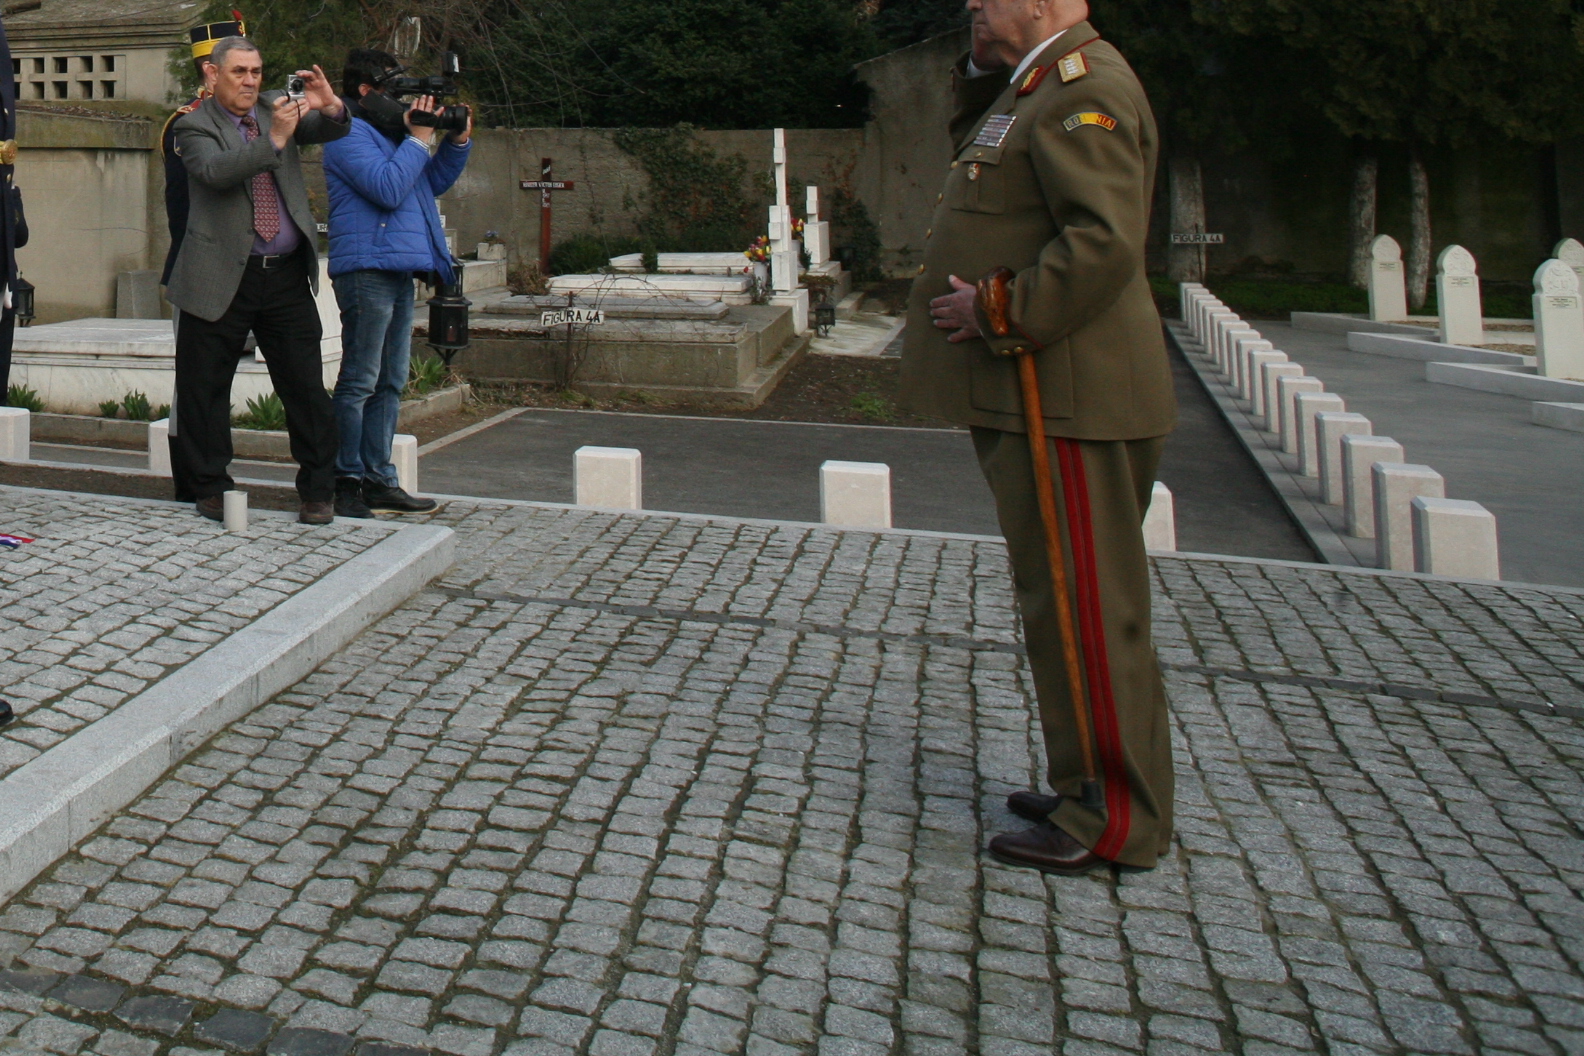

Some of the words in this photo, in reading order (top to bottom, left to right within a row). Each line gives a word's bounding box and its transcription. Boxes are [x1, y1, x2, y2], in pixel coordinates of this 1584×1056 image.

[1066, 114, 1113, 128] RONIA
[1172, 234, 1207, 243] FIGURA
[1209, 234, 1221, 242] 4A
[543, 310, 582, 326] FIGURA
[585, 310, 601, 324] 4A
